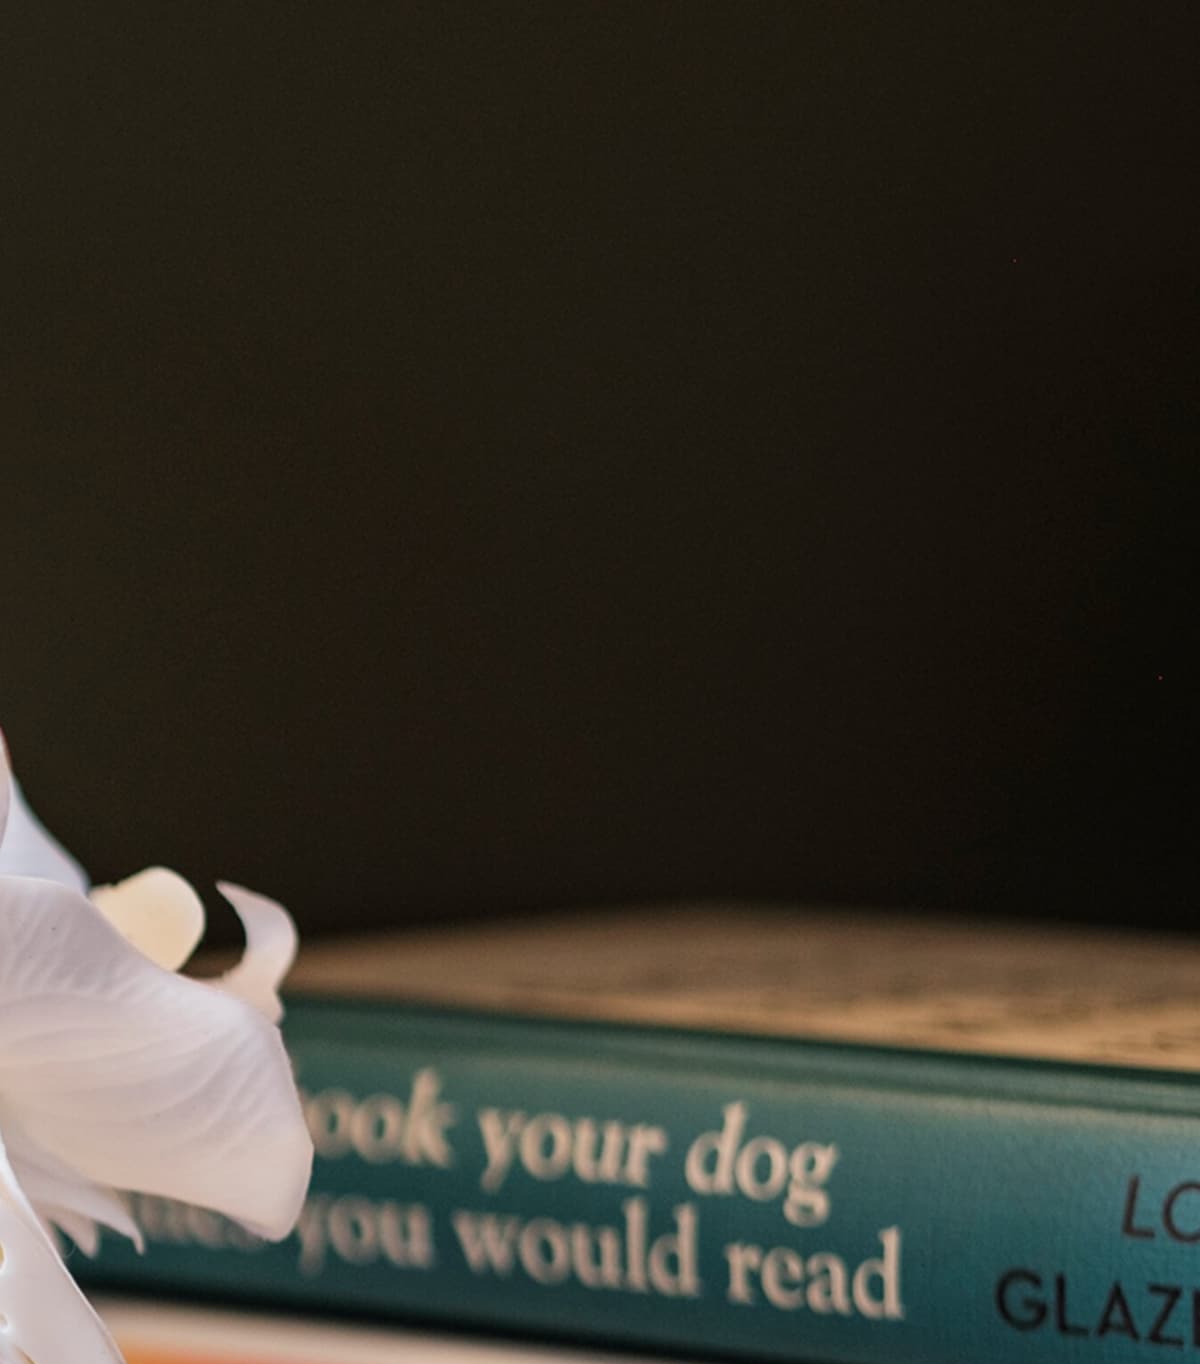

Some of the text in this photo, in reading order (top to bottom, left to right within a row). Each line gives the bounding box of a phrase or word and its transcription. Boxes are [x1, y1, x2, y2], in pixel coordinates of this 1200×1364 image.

[300, 1066, 841, 1227] ook your dog
[297, 1194, 434, 1275] you
[451, 1197, 699, 1298] would
[724, 1226, 905, 1321] read
